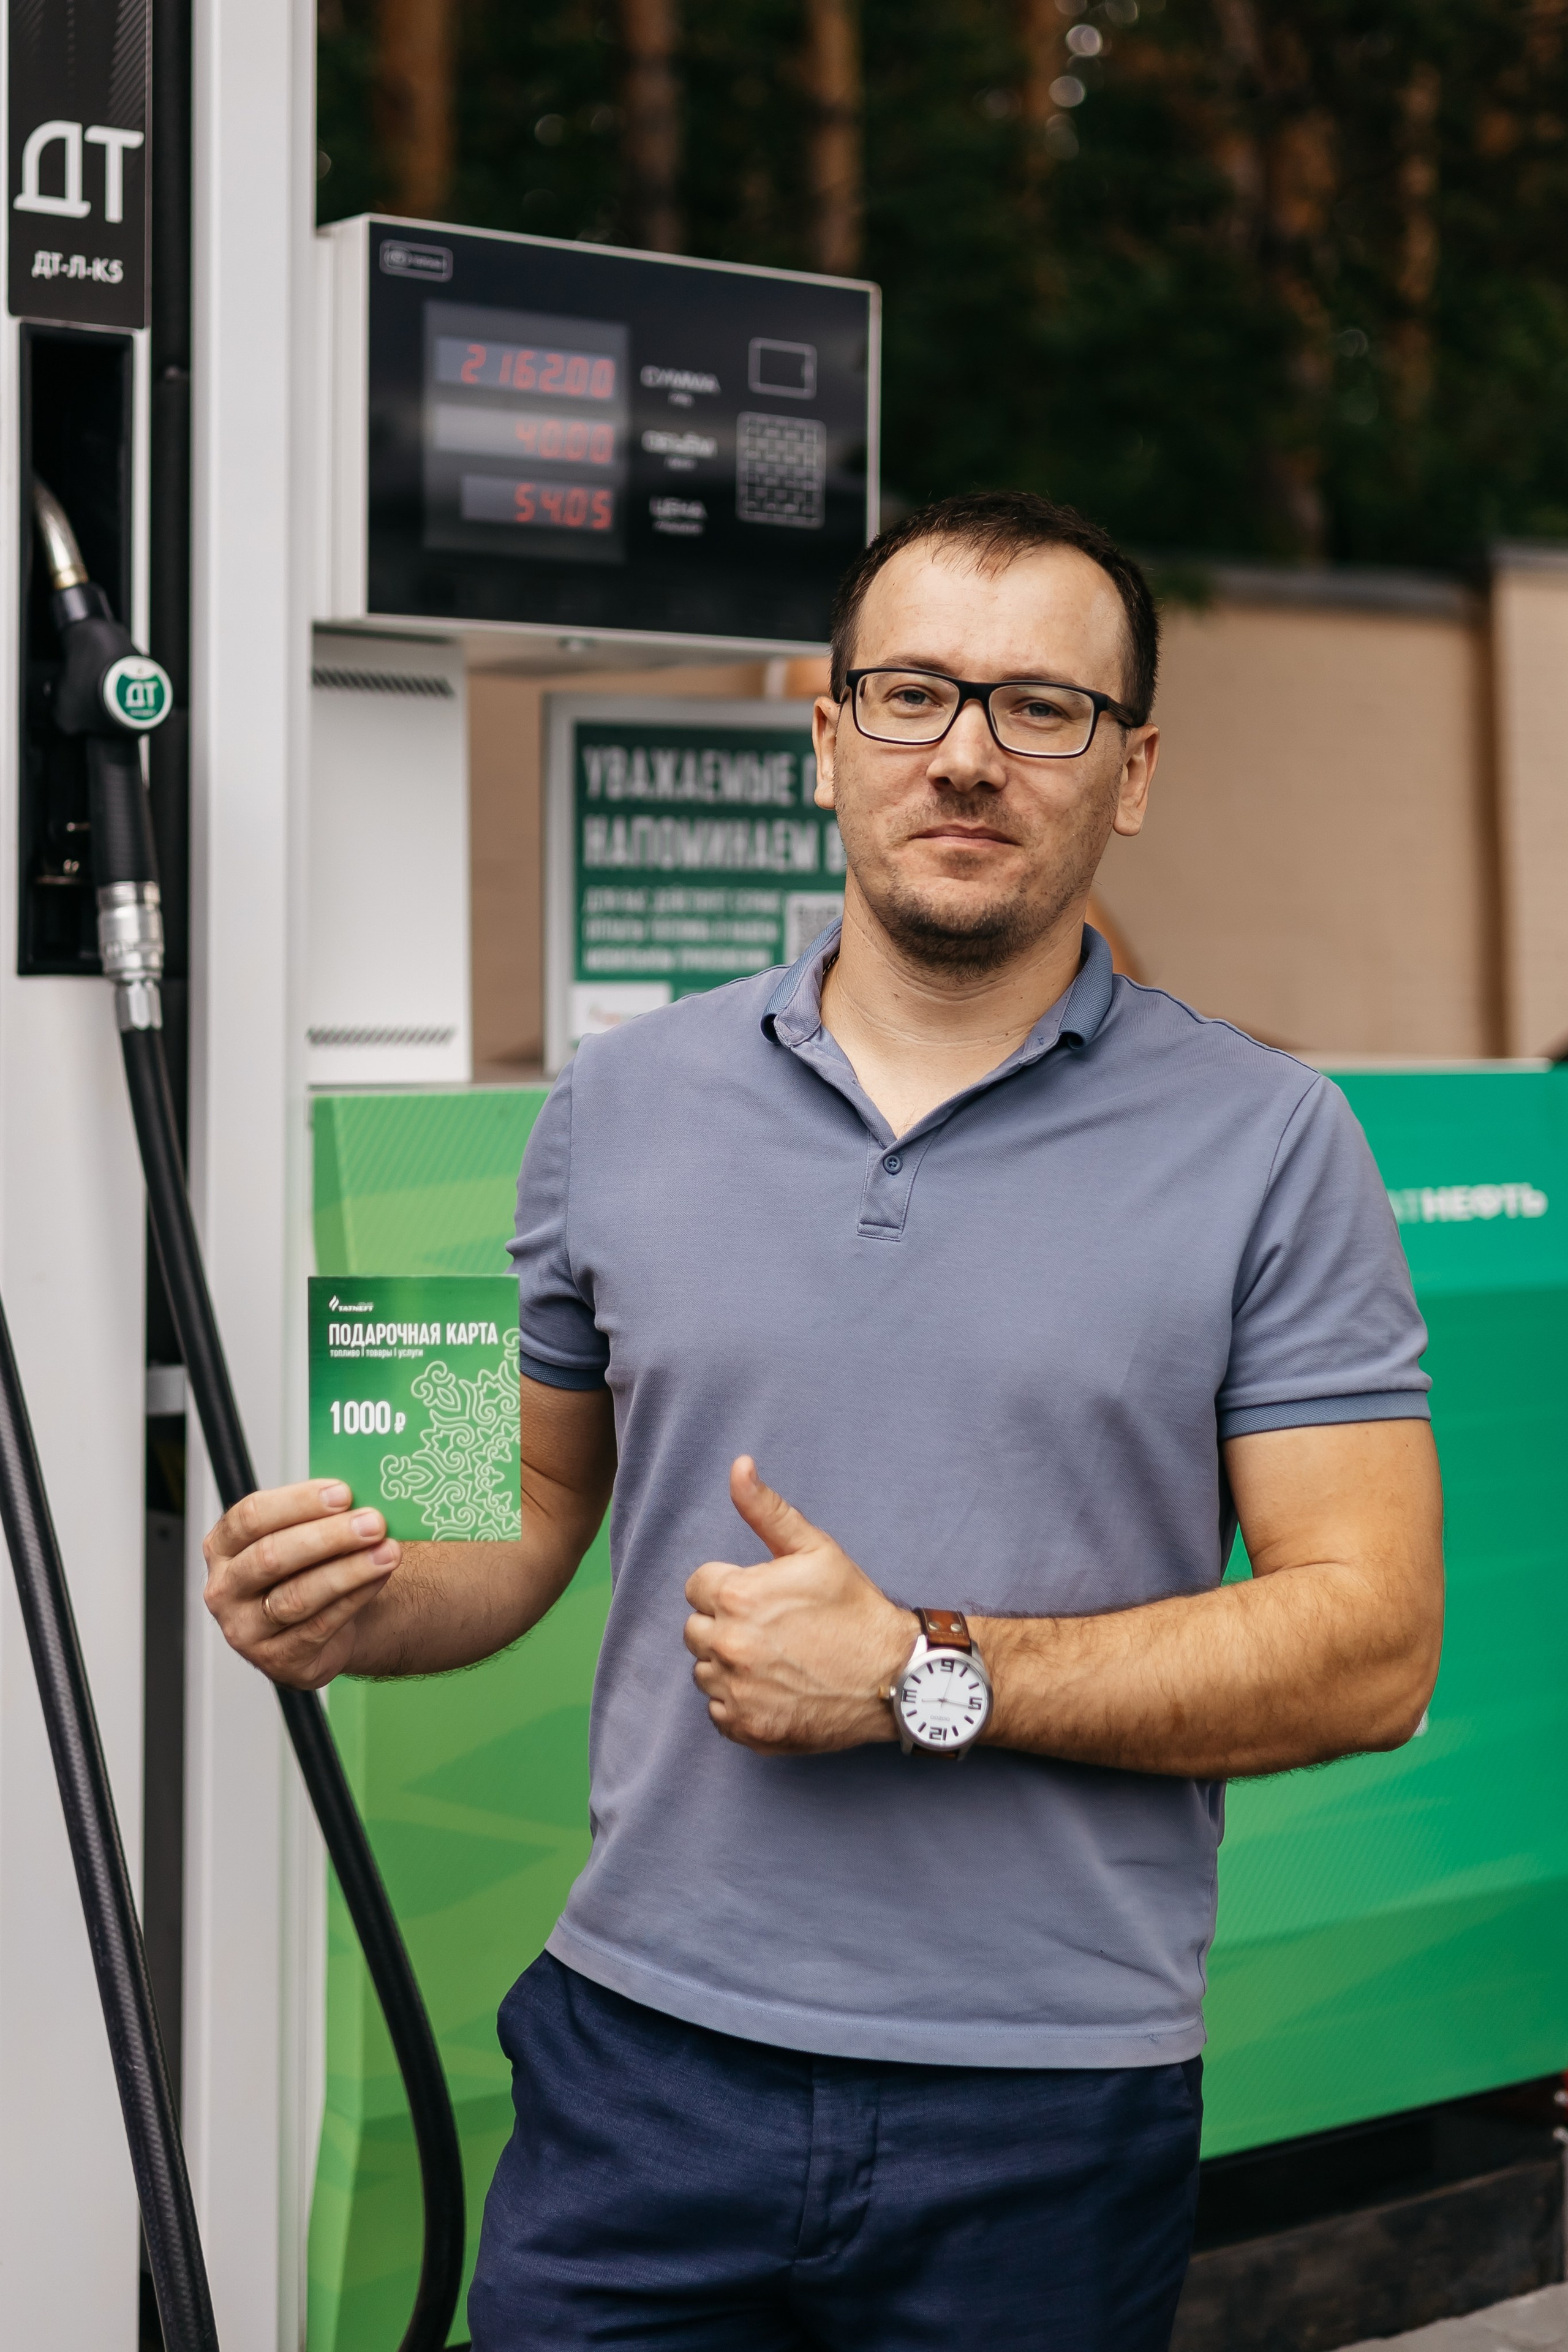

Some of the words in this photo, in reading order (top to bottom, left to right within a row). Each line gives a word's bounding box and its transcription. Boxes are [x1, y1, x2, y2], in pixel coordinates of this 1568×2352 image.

[13, 120, 144, 222] ДТ
[32, 250, 124, 283] ДТ-Л-К5
[126, 681, 158, 707] ДТ
[583, 746, 794, 806] УВАЖАЕМЫЕ
[584, 814, 819, 874] НАПОМИНАЕМ
[328, 1323, 440, 1348] ПОДАРОЧНАЯ
[446, 1323, 499, 1345] КАРТА
[366, 1349, 393, 1359] товары
[399, 1349, 423, 1359] услуги
[330, 1401, 391, 1434] 1000
[929, 1727, 948, 1741] 12
